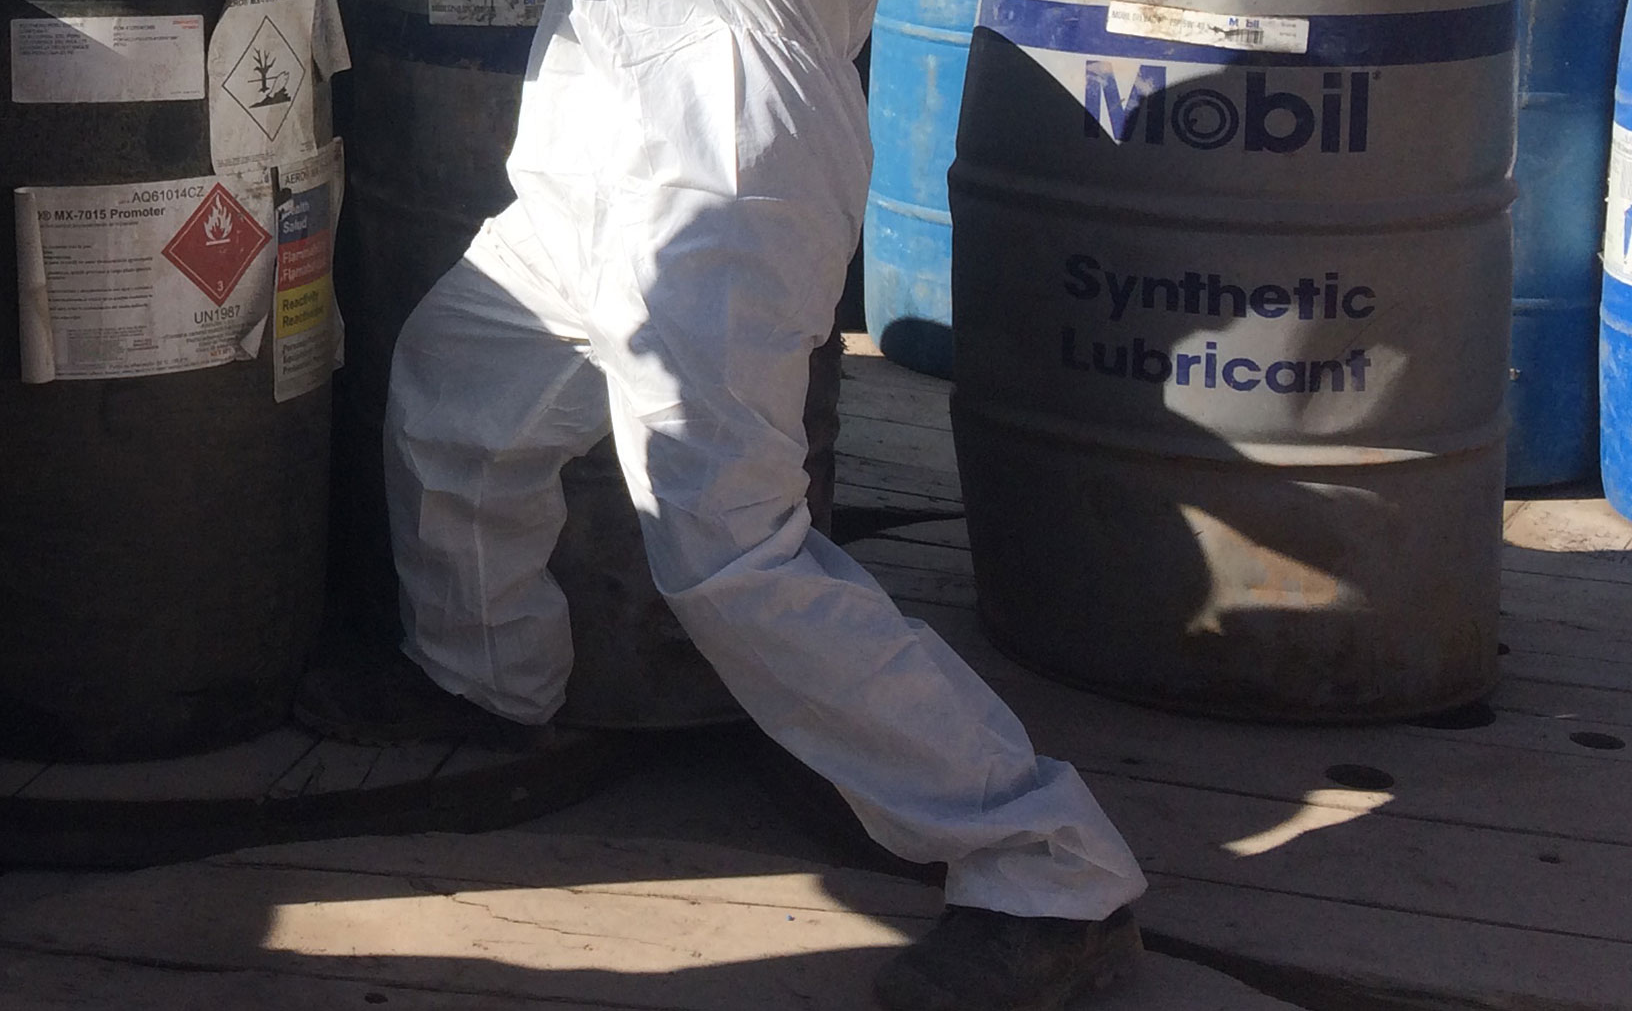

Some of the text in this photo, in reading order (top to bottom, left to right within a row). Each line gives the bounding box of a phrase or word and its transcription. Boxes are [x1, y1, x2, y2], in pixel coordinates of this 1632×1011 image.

[132, 186, 204, 204] AQ61014CZ
[55, 209, 107, 221] MX-7015
[110, 206, 166, 219] Promoter
[217, 280, 224, 292] 3
[1062, 254, 1377, 322] Synthetic
[194, 305, 241, 325] UN1987
[1060, 329, 1372, 393] Lubricant
